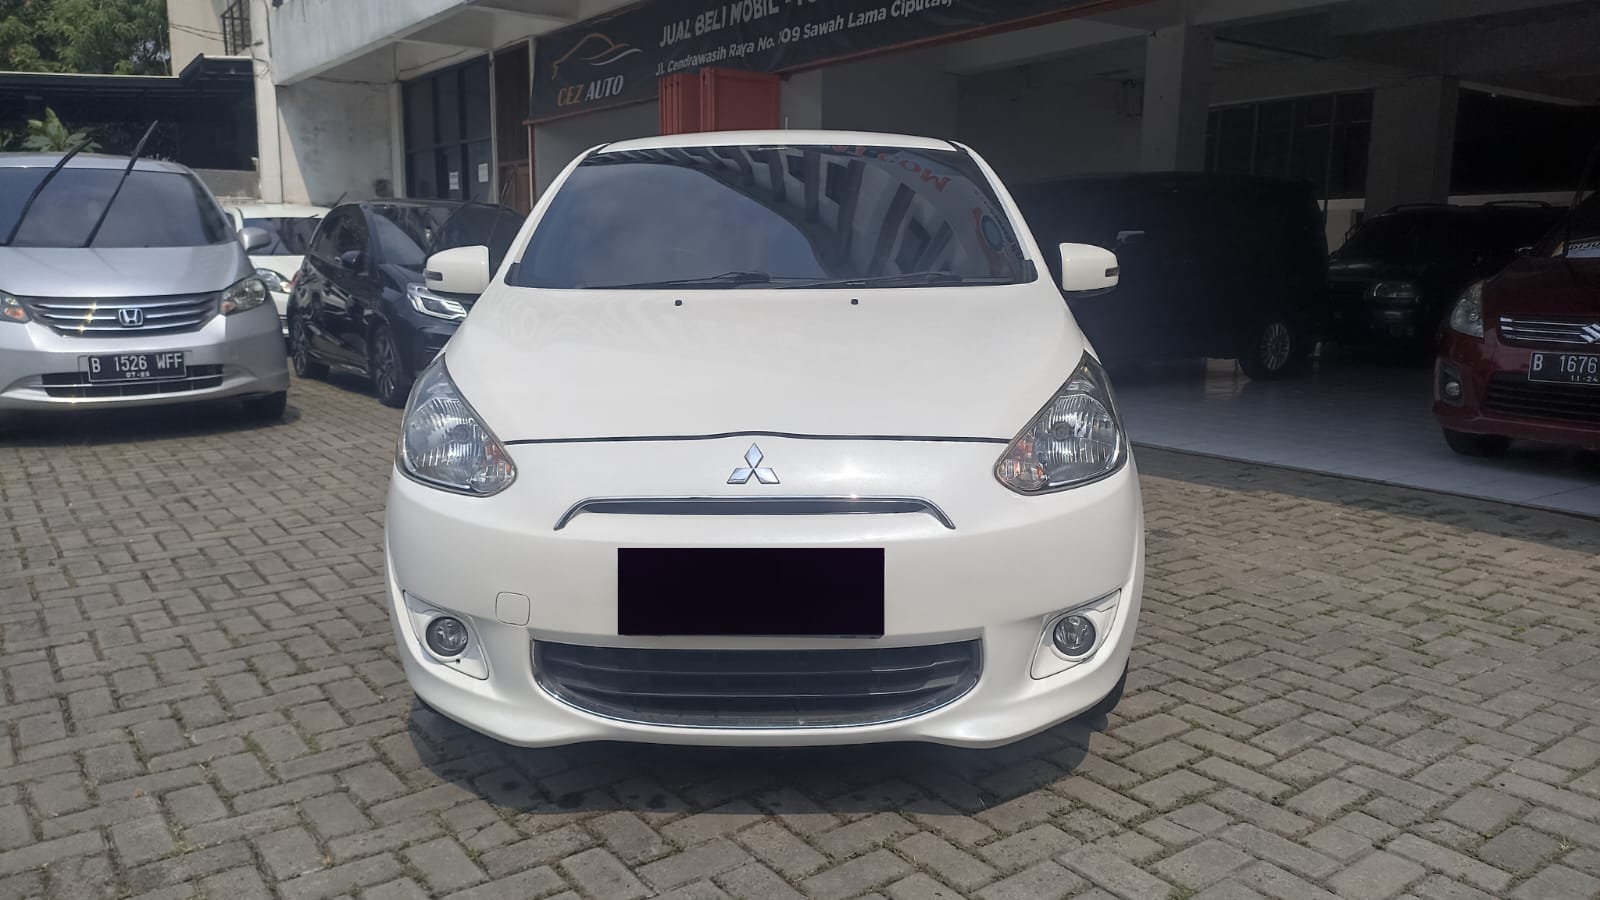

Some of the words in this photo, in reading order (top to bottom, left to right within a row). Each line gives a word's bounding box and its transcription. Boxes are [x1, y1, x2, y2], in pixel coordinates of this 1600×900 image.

[659, 18, 692, 47] JUAL
[695, 6, 727, 36] BELI
[729, 0, 780, 26] MOBIL
[667, 46, 727, 73] Cendrawasih
[728, 41, 755, 57] Raya
[757, 36, 775, 52] No.
[777, 26, 800, 44] 109
[803, 15, 844, 38] Sawah
[847, 7, 887, 28] Lama
[557, 84, 584, 107] CEZ
[584, 74, 624, 102] AUTO
[90, 357, 101, 373] B
[114, 355, 148, 372] 1526
[155, 353, 183, 369] WFF
[1533, 354, 1544, 371] B
[1560, 355, 1598, 374] 1676
